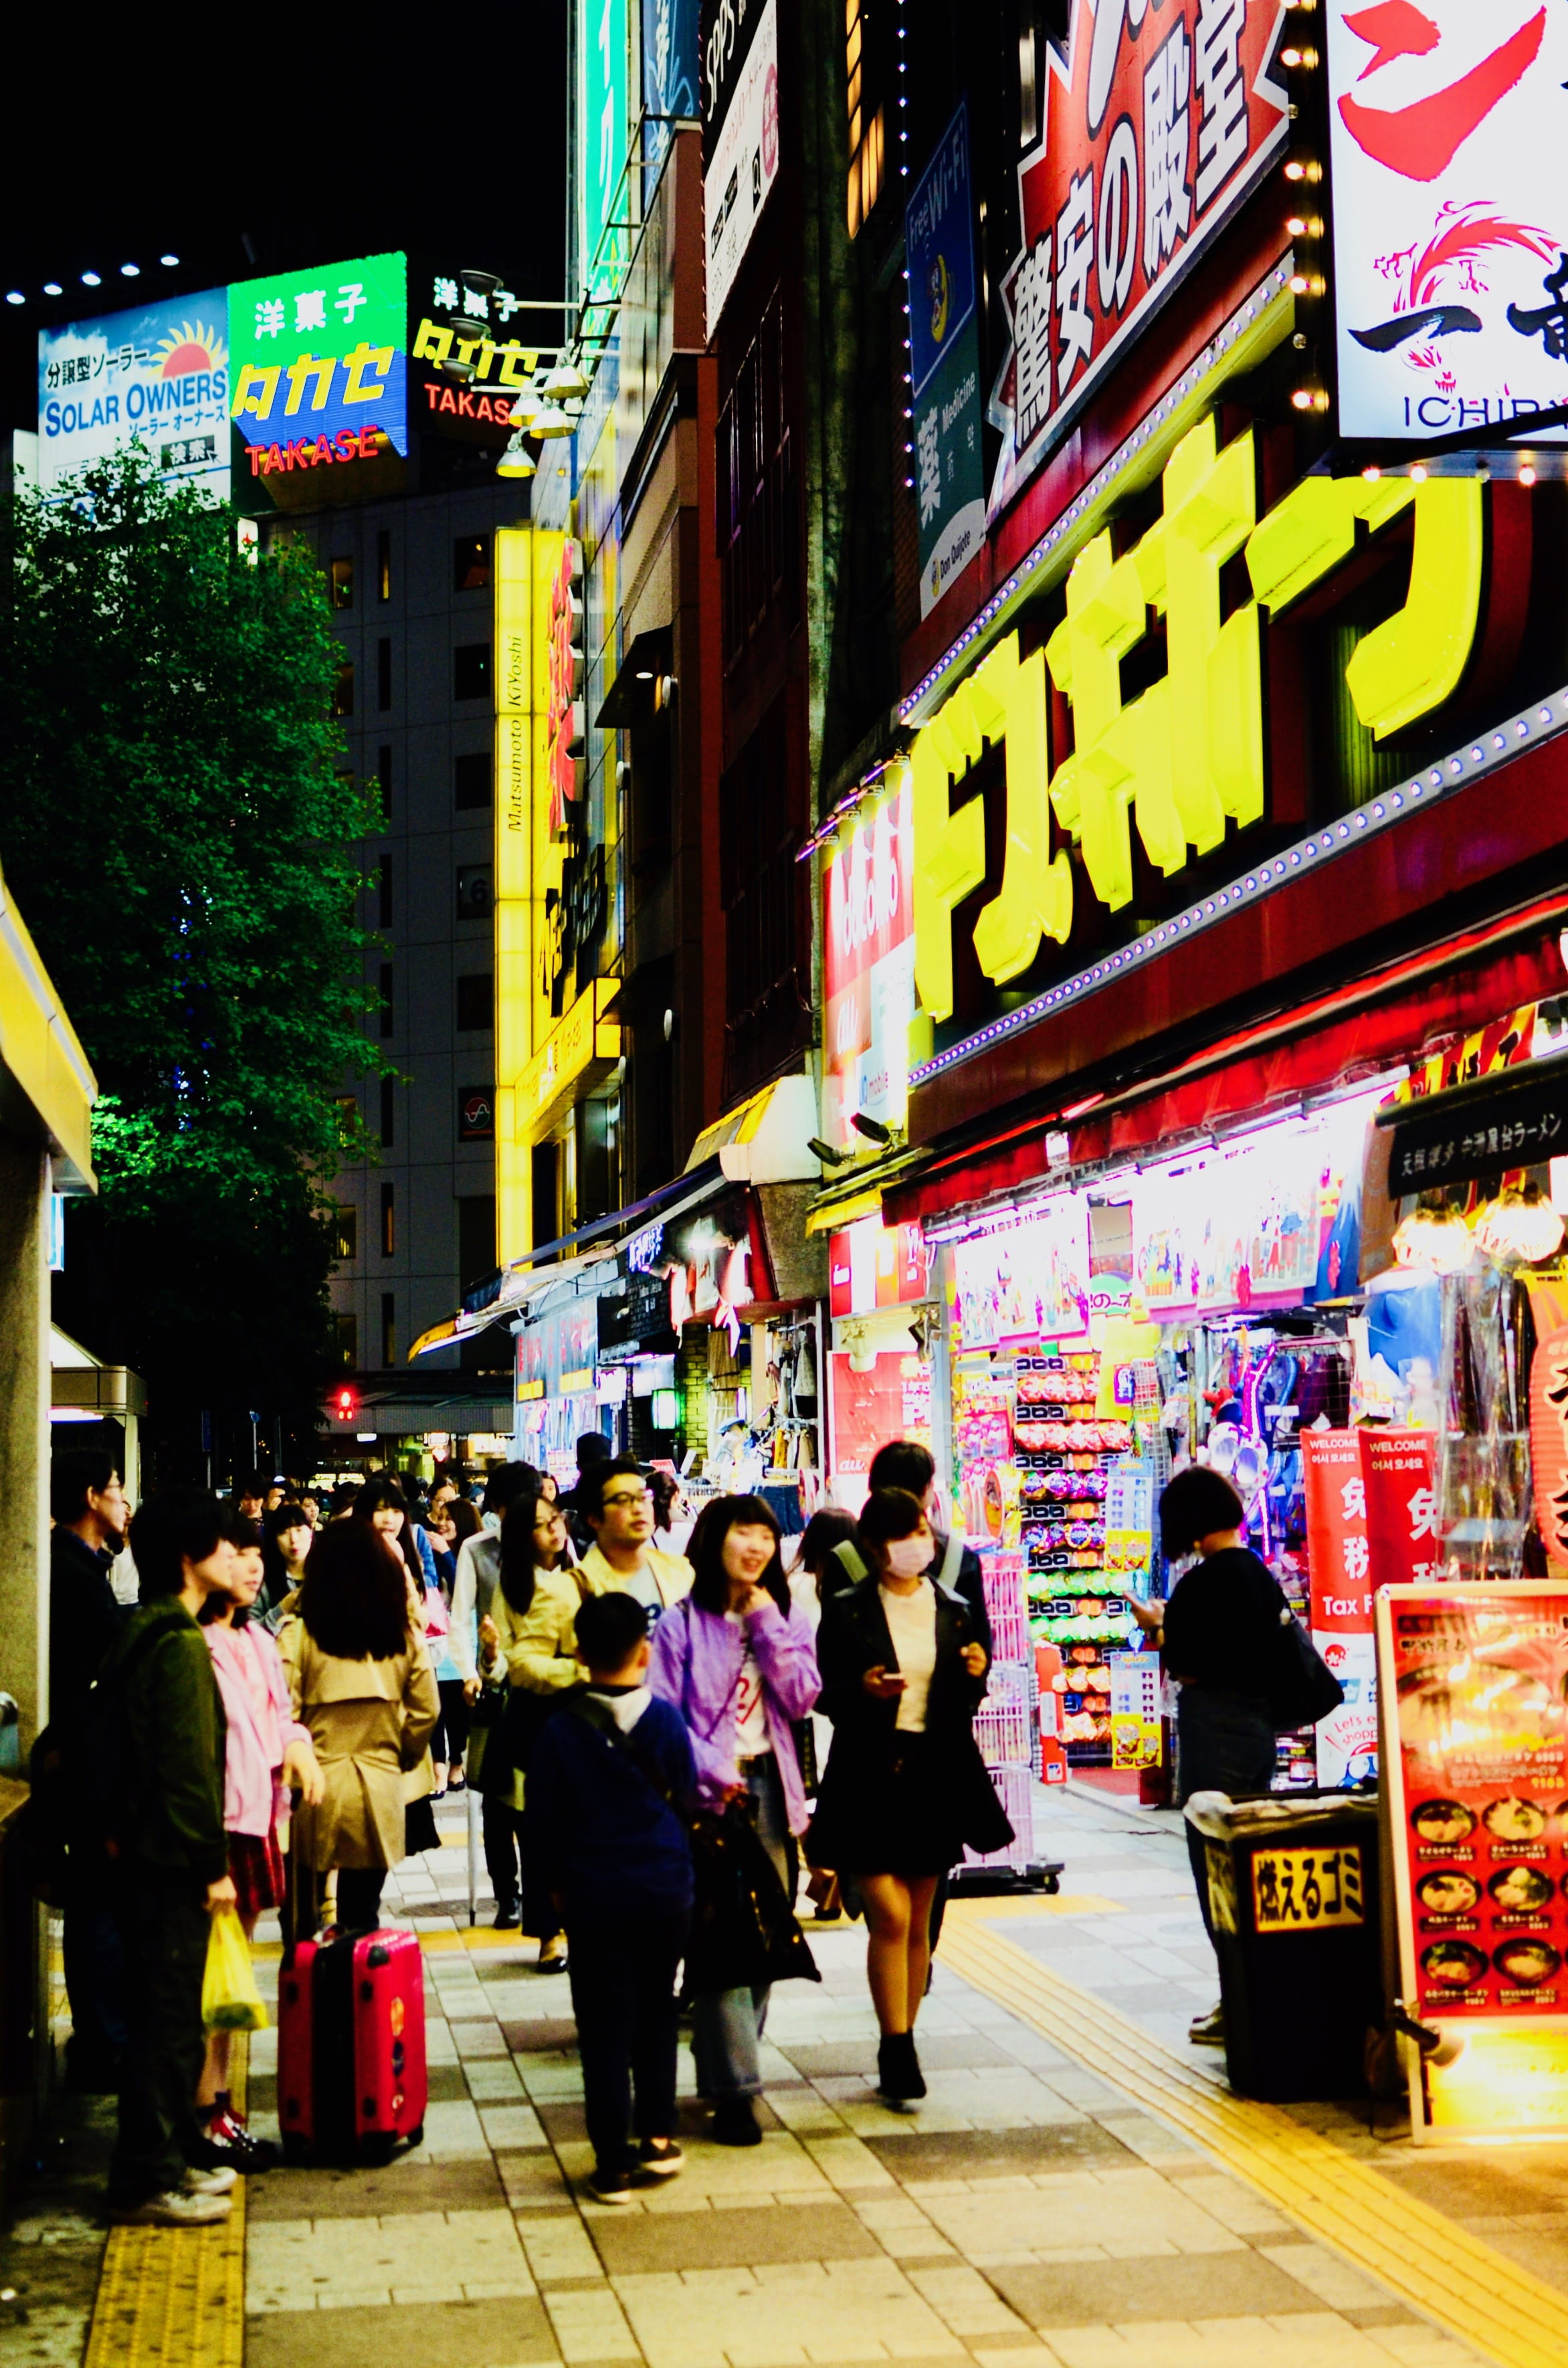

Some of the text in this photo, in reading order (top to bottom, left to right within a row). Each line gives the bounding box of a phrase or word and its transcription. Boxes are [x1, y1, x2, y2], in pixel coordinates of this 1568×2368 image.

[928, 118, 965, 233] Wi-Fi
[254, 283, 367, 340] 洋菓子
[433, 276, 518, 322] 洋菓子
[47, 347, 149, 389] 分譲型ソーラー
[412, 318, 539, 387] タカセ
[45, 371, 227, 438] SOLAR OWNERS
[230, 342, 395, 419] タカセ
[942, 372, 975, 434] Medicine
[129, 417, 169, 438] ソーラー
[424, 383, 519, 427] TAKAS
[170, 439, 205, 465] 検索
[245, 425, 379, 476] TAKASE
[940, 530, 971, 580] Don Quijote
[508, 636, 522, 832] Matsumoto KiYoshi
[1310, 1439, 1359, 1450] WELCOME
[1369, 1440, 1428, 1453] WELCOME
[1322, 1596, 1358, 1617] Tax
[1334, 1713, 1362, 1733] Let's
[1343, 1729, 1378, 1746] shopp
[1257, 1852, 1363, 1922] 燃えるゴミ
